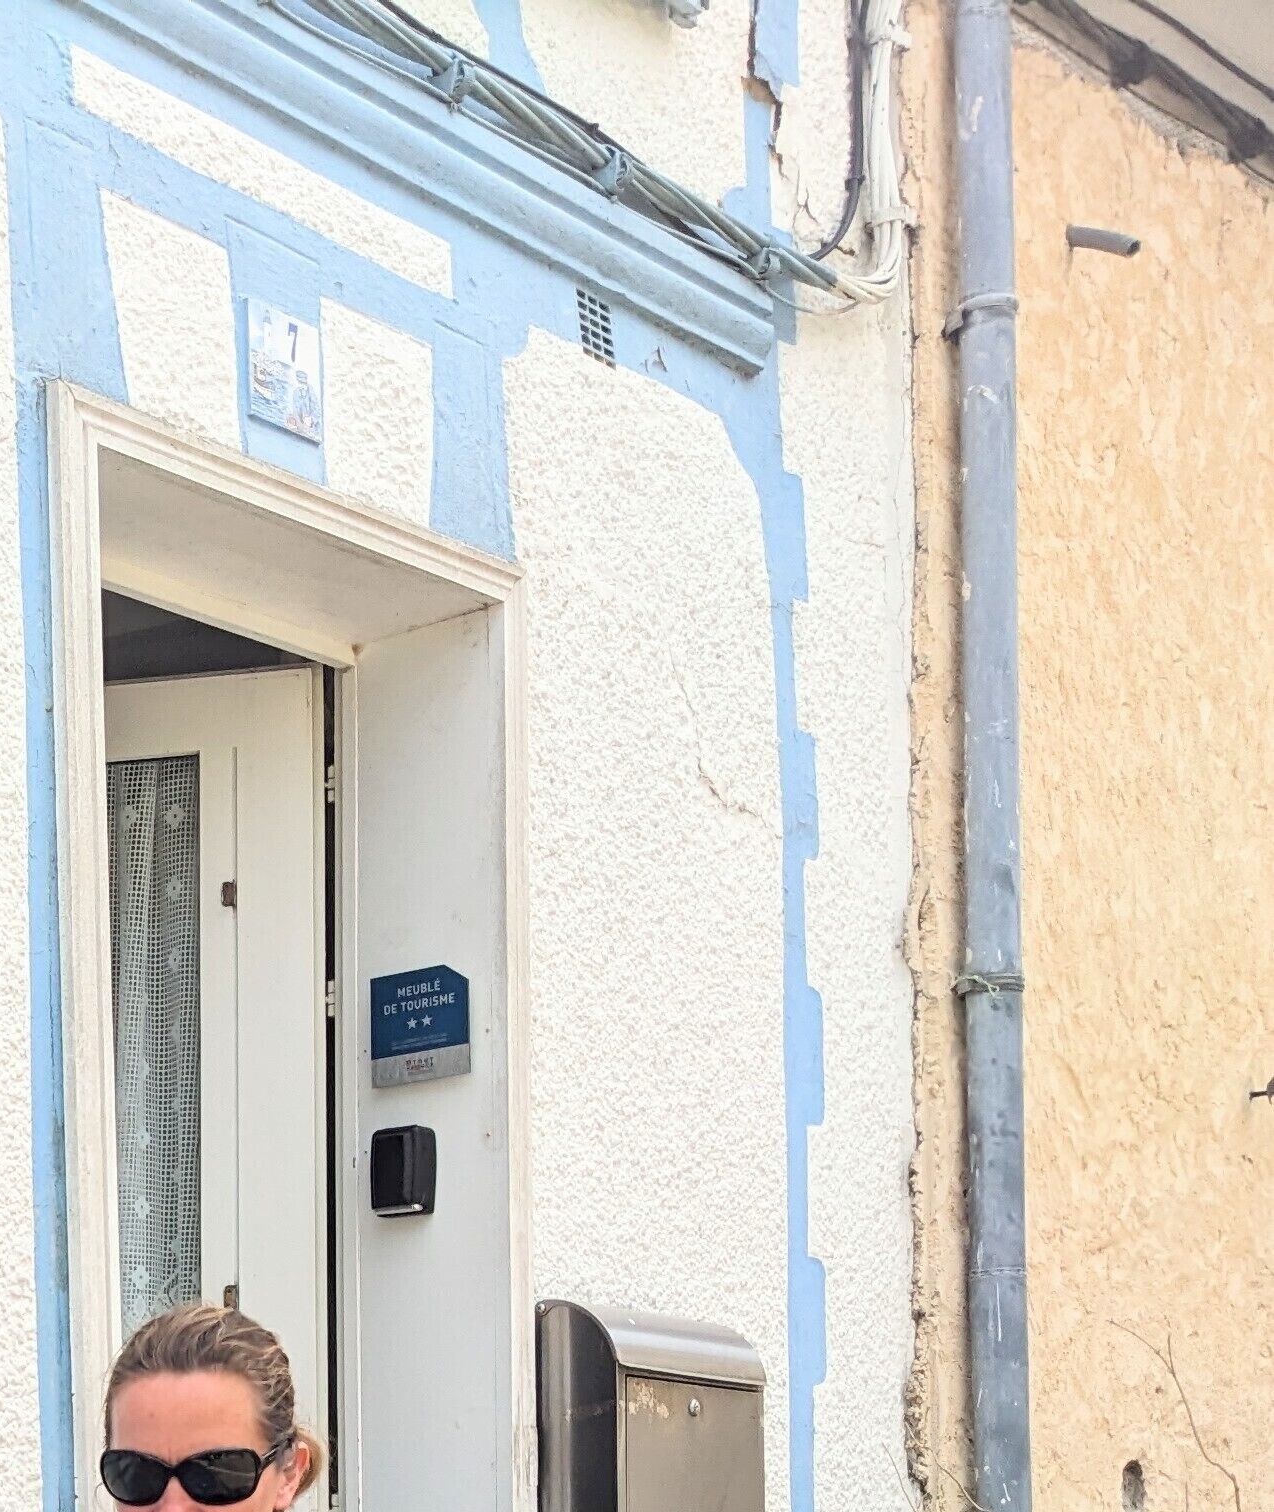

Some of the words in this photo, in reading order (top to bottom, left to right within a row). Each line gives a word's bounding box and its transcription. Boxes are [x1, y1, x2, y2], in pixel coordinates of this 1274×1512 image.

[288, 322, 298, 362] 7
[397, 978, 441, 998] MEUBLÉ
[383, 1003, 398, 1016] DE
[400, 992, 455, 1012] TOURISME
